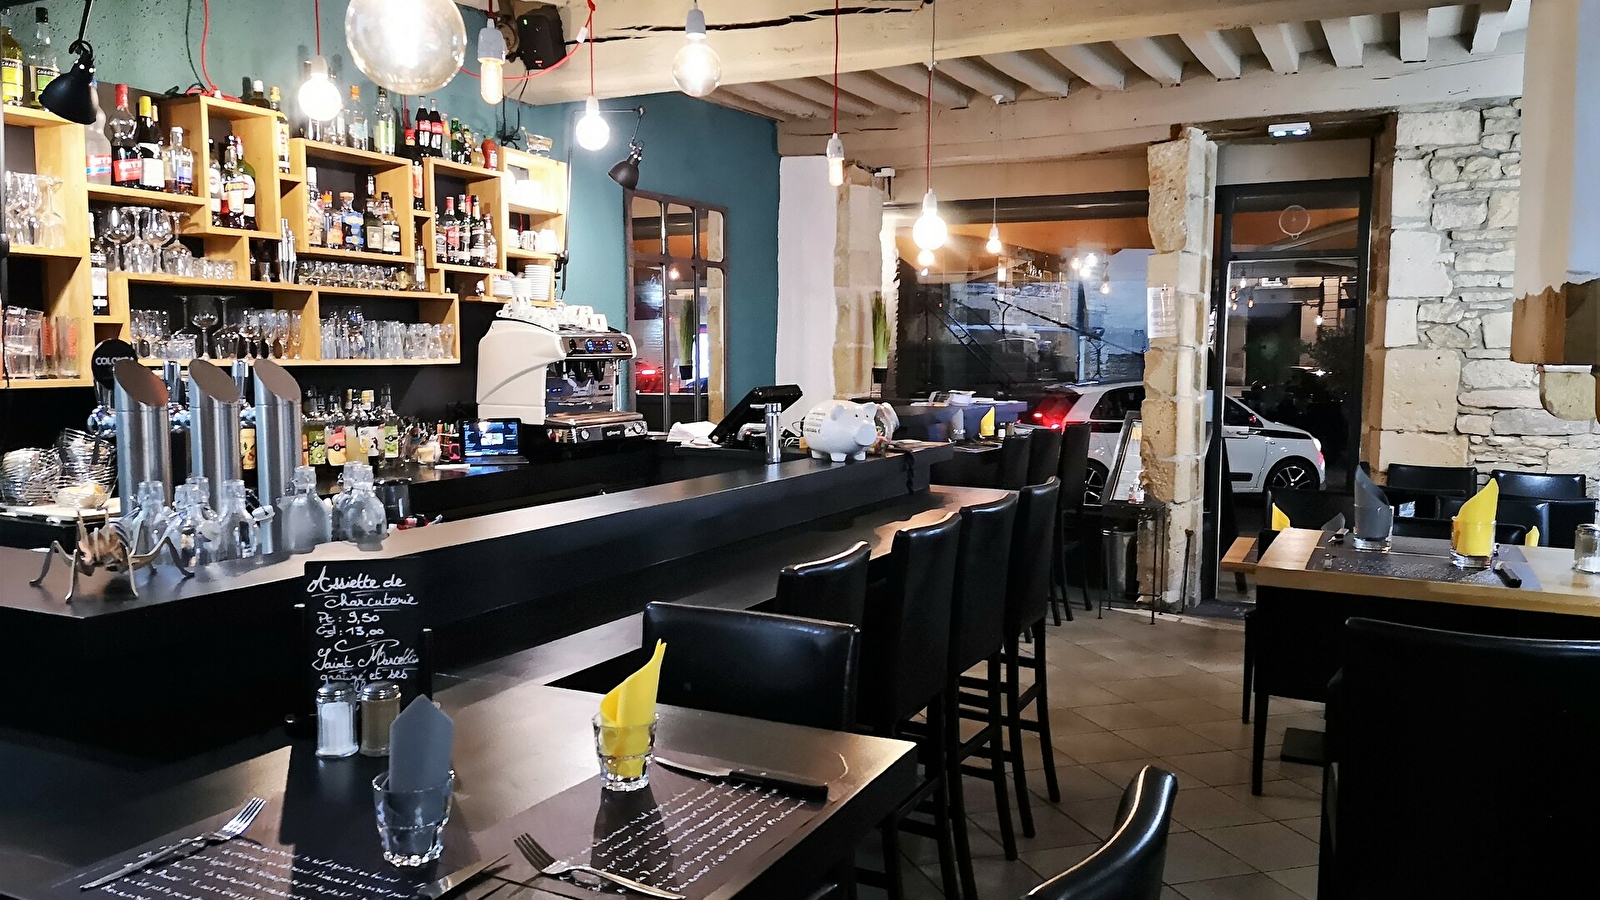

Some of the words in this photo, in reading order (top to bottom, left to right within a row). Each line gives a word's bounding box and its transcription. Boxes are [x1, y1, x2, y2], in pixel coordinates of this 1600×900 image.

[307, 565, 381, 593] Assiette
[383, 573, 407, 588] de
[347, 610, 380, 624] 9,50
[345, 626, 385, 638] 13,00
[312, 648, 354, 671] Saint
[369, 667, 383, 680] et
[387, 668, 408, 680] ses
